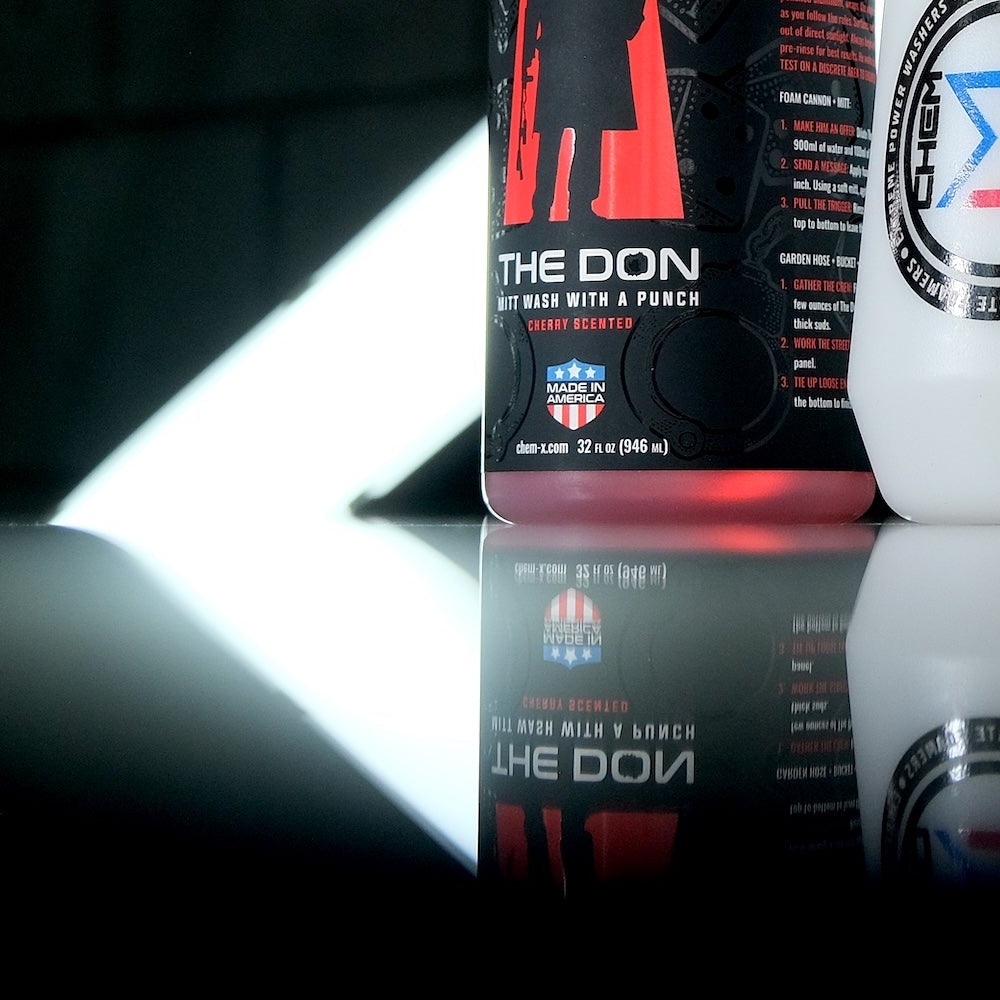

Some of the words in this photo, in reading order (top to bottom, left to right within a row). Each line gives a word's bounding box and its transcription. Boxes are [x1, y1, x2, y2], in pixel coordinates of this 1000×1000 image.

[780, 9, 789, 18] as
[791, 11, 805, 21] you
[807, 10, 826, 22] follow
[828, 12, 837, 23] the
[780, 26, 793, 36] out
[795, 26, 803, 36] of
[805, 27, 825, 39] direct
[780, 43, 814, 55] pre-rinse
[816, 45, 826, 56] for
[827, 46, 839, 58] best
[780, 58, 798, 71] TEST
[800, 60, 811, 72] ON
[812, 61, 817, 73] A
[819, 62, 847, 77] DISCRETE
[780, 91, 801, 104] FOAM
[803, 92, 831, 107] CANNON
[888, 85, 907, 152] POWER
[781, 119, 787, 131] 1.
[793, 119, 814, 132] MAKE
[816, 120, 829, 134] HIM
[830, 122, 839, 135] AN
[793, 139, 817, 152] 900ml
[819, 142, 826, 152] of
[827, 143, 843, 154] water
[913, 71, 943, 210] CHEM
[781, 157, 788, 169] 2.
[793, 158, 813, 170] SEND
[814, 159, 820, 171] A
[793, 178, 811, 190] inch.
[813, 179, 831, 194] Using
[832, 184, 837, 192] a
[781, 197, 788, 209] 3.
[793, 197, 812, 209] PULL
[813, 198, 827, 211] THE
[793, 217, 807, 231] top
[807, 218, 816, 229] to
[816, 218, 839, 231] bottom
[840, 220, 846, 231] to
[498, 249, 566, 286] THE
[579, 247, 700, 282] DON
[779, 252, 811, 265] GARDEN
[812, 253, 831, 267] HOSE
[836, 255, 857, 268] BUCKET
[780, 278, 788, 290] 1.
[793, 279, 822, 291] GATHER
[823, 280, 835, 292] THE
[906, 257, 965, 311] AMERS
[523, 293, 559, 309] WASH
[567, 292, 609, 308] WITH
[618, 291, 628, 306] A
[637, 291, 700, 307] PUNCH
[793, 298, 807, 310] few
[809, 301, 832, 311] ounces
[833, 301, 840, 311] of
[840, 301, 850, 312] The
[528, 318, 568, 332] CHERRY
[573, 317, 634, 330] SCENTED
[793, 318, 812, 330] thick
[814, 320, 831, 331] suds.
[780, 337, 788, 349] 2.
[793, 338, 816, 350] WORK
[818, 338, 830, 350] THE
[793, 357, 816, 369] panel.
[546, 382, 588, 393] MADE
[592, 382, 605, 393] IN
[780, 376, 788, 388] 3.
[793, 377, 805, 388] TIE
[807, 377, 818, 389] UP
[819, 378, 839, 390] LOOSE
[546, 393, 605, 404] AMERICA
[793, 396, 807, 408] the
[808, 397, 833, 409] bottom
[834, 398, 840, 409] to
[516, 439, 569, 455] chem-x.com
[577, 439, 592, 454] 32
[594, 444, 605, 453] FL
[605, 444, 616, 453] OZ
[619, 439, 649, 456] (946
[651, 439, 669, 456] ML)
